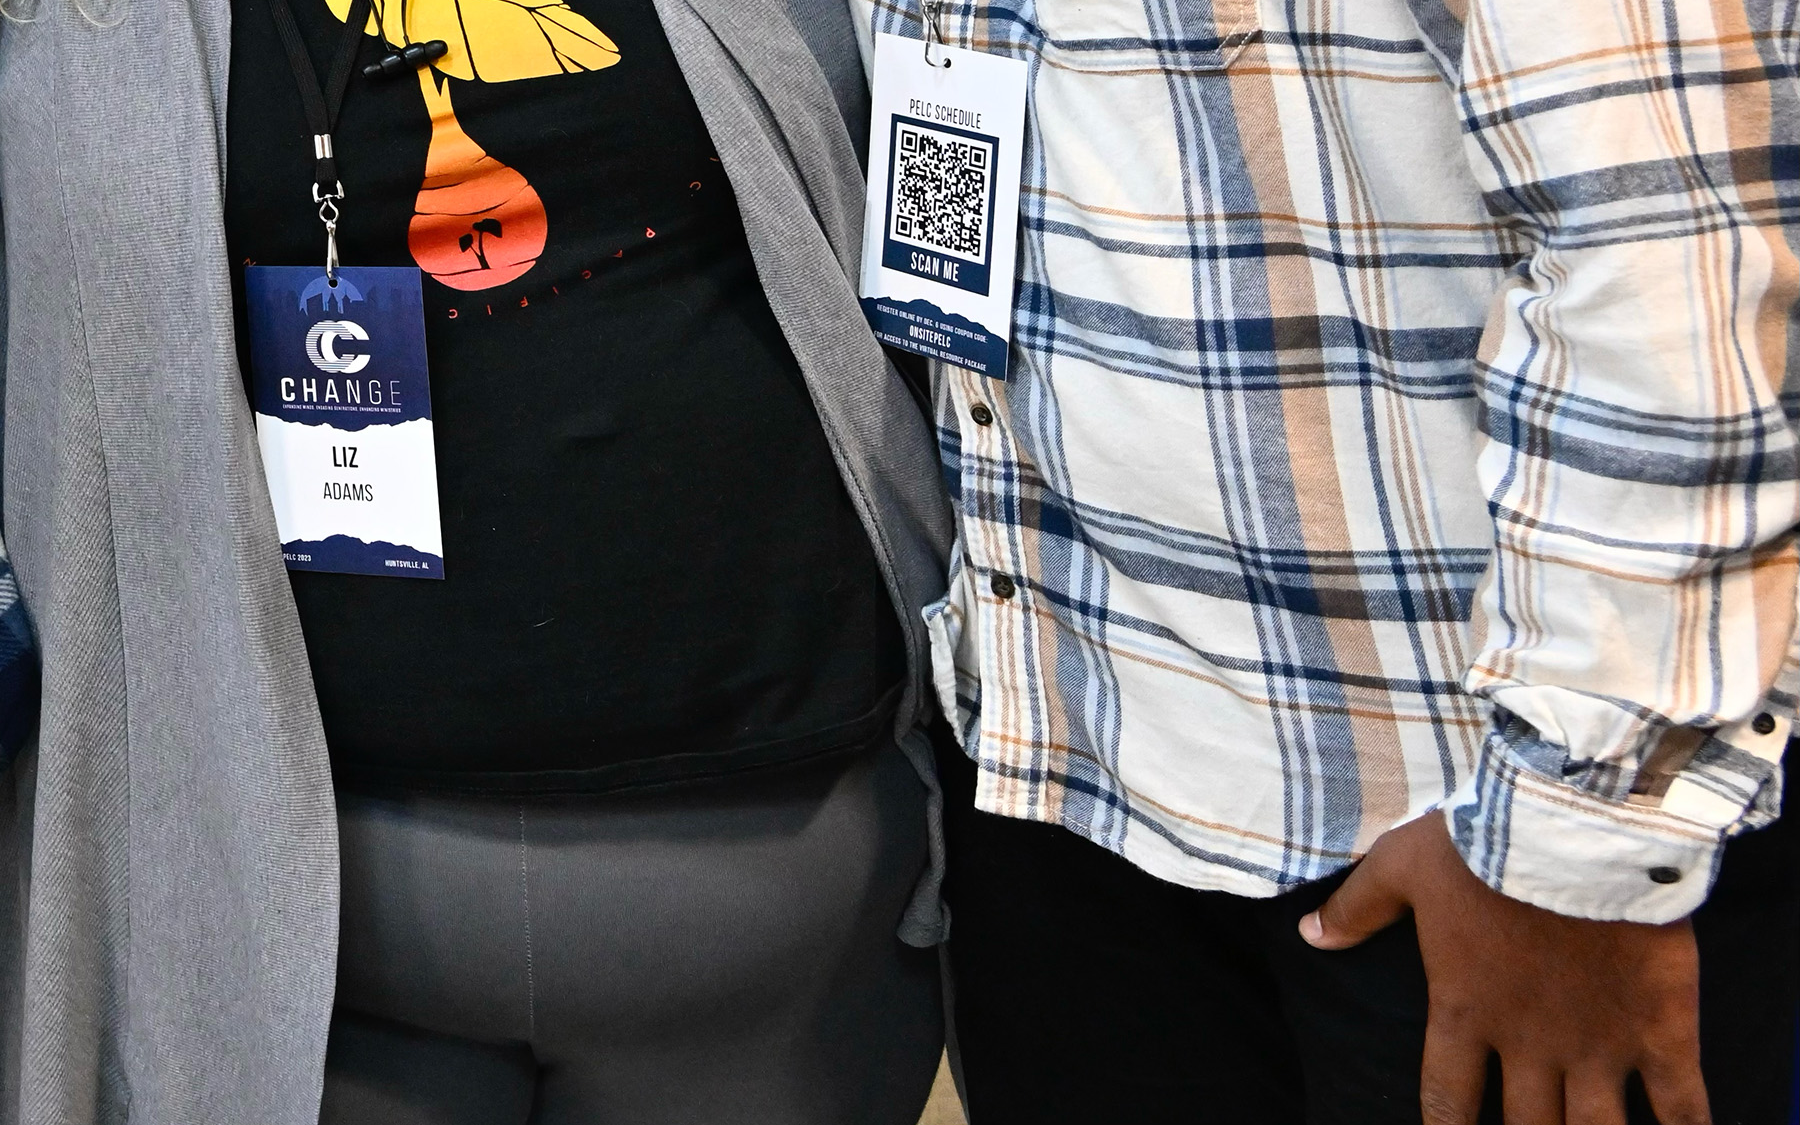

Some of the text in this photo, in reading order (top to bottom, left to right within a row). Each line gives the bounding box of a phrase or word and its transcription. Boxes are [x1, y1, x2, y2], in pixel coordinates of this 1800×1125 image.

[909, 98, 982, 129] PELC SCHEDULE
[910, 251, 960, 283] SCAN ME
[876, 304, 899, 316] REGISTER
[883, 333, 901, 344] ACCESS
[902, 338, 908, 347] TO
[909, 325, 951, 348] ONSITEPELC
[280, 377, 402, 406] CHANGE
[332, 446, 359, 468] LIZ
[323, 482, 374, 502] ADAMS
[283, 553, 312, 562] PELC 2023
[422, 561, 429, 569] AL
